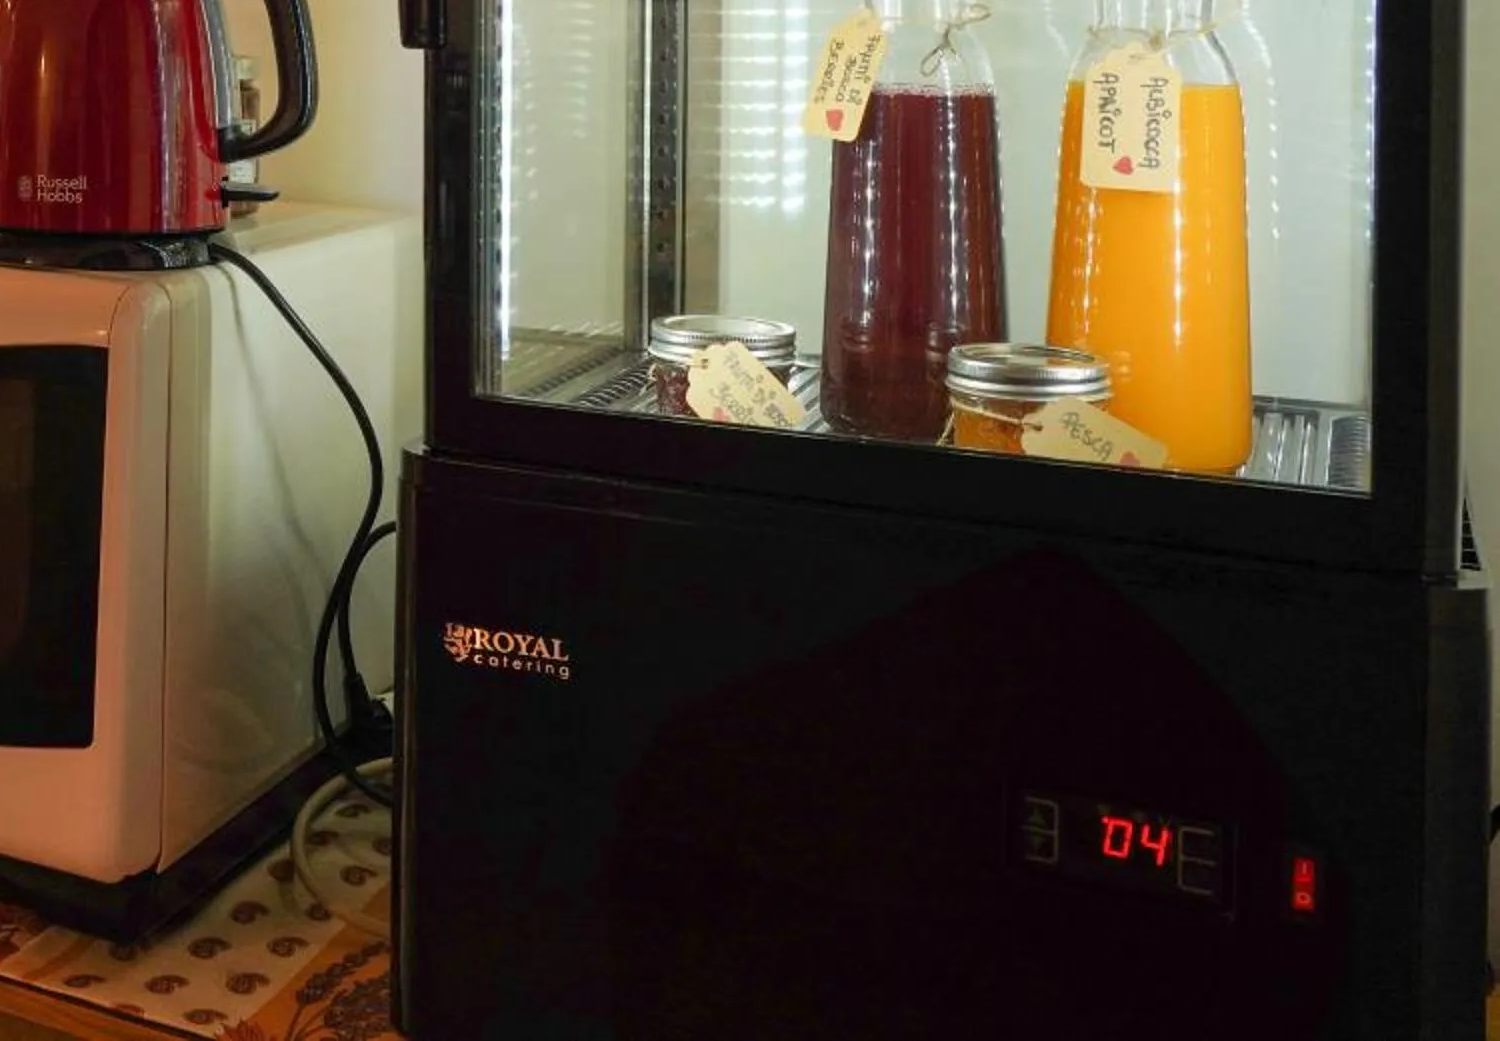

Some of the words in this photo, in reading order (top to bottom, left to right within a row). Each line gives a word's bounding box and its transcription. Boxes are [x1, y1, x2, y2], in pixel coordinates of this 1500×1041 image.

[36, 174, 88, 190] Russell
[36, 188, 84, 204] Hobbs
[1060, 411, 1115, 462] PESCA
[473, 627, 570, 662] ROYAL
[473, 653, 570, 680] catering
[1101, 816, 1169, 866] 04
